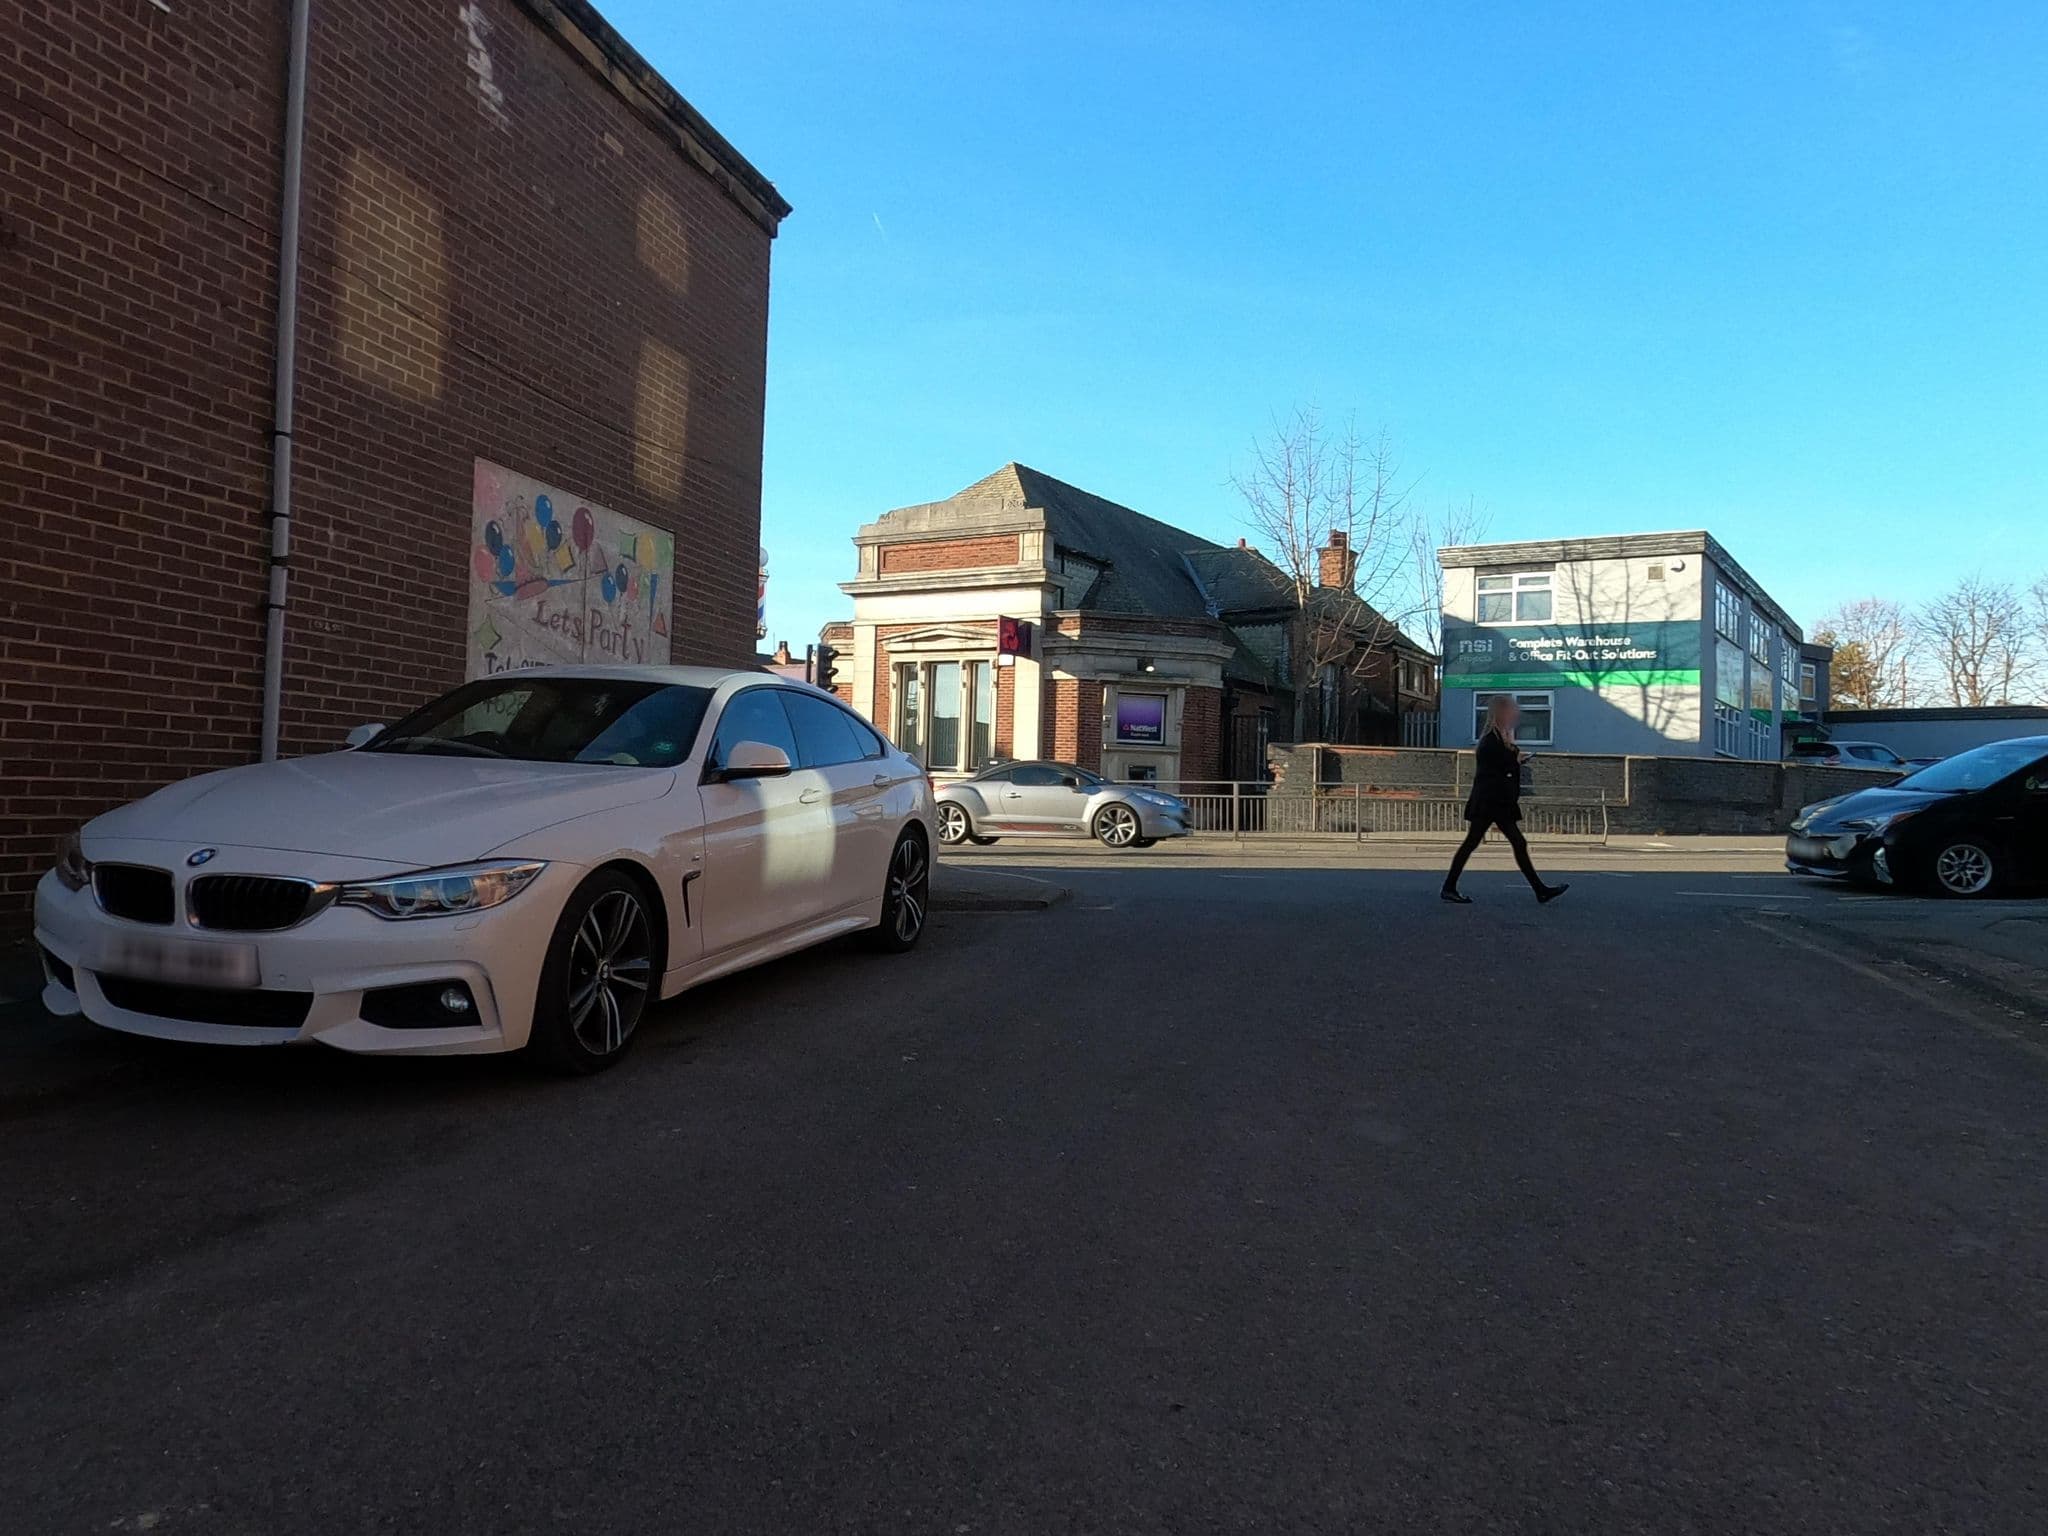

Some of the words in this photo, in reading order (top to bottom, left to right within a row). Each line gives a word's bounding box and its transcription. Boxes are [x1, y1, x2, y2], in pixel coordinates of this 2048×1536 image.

[588, 608, 644, 664] Party
[1508, 636, 1562, 650] Complete
[1565, 635, 1631, 647] Warehouse
[1459, 639, 1493, 653] nsi
[1508, 652, 1517, 662] &
[1520, 650, 1553, 661] Office
[1556, 649, 1599, 661] Fit-Out
[1601, 648, 1657, 660] Solutions
